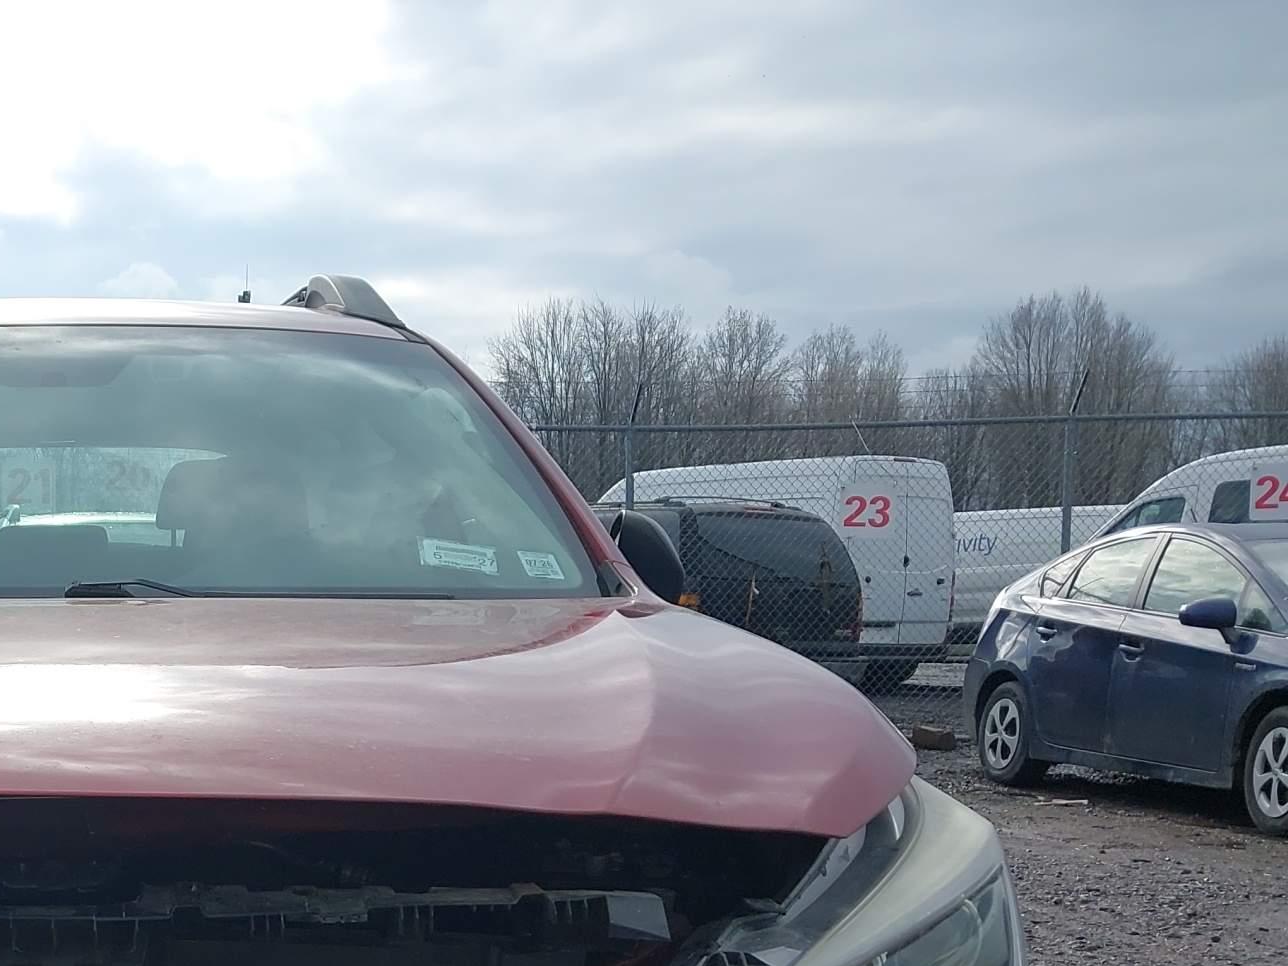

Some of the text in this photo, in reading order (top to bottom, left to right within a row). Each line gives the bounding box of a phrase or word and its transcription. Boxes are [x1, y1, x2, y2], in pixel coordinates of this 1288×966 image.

[8, 467, 51, 504] 21
[843, 495, 891, 528] 23
[957, 533, 998, 556] ivity
